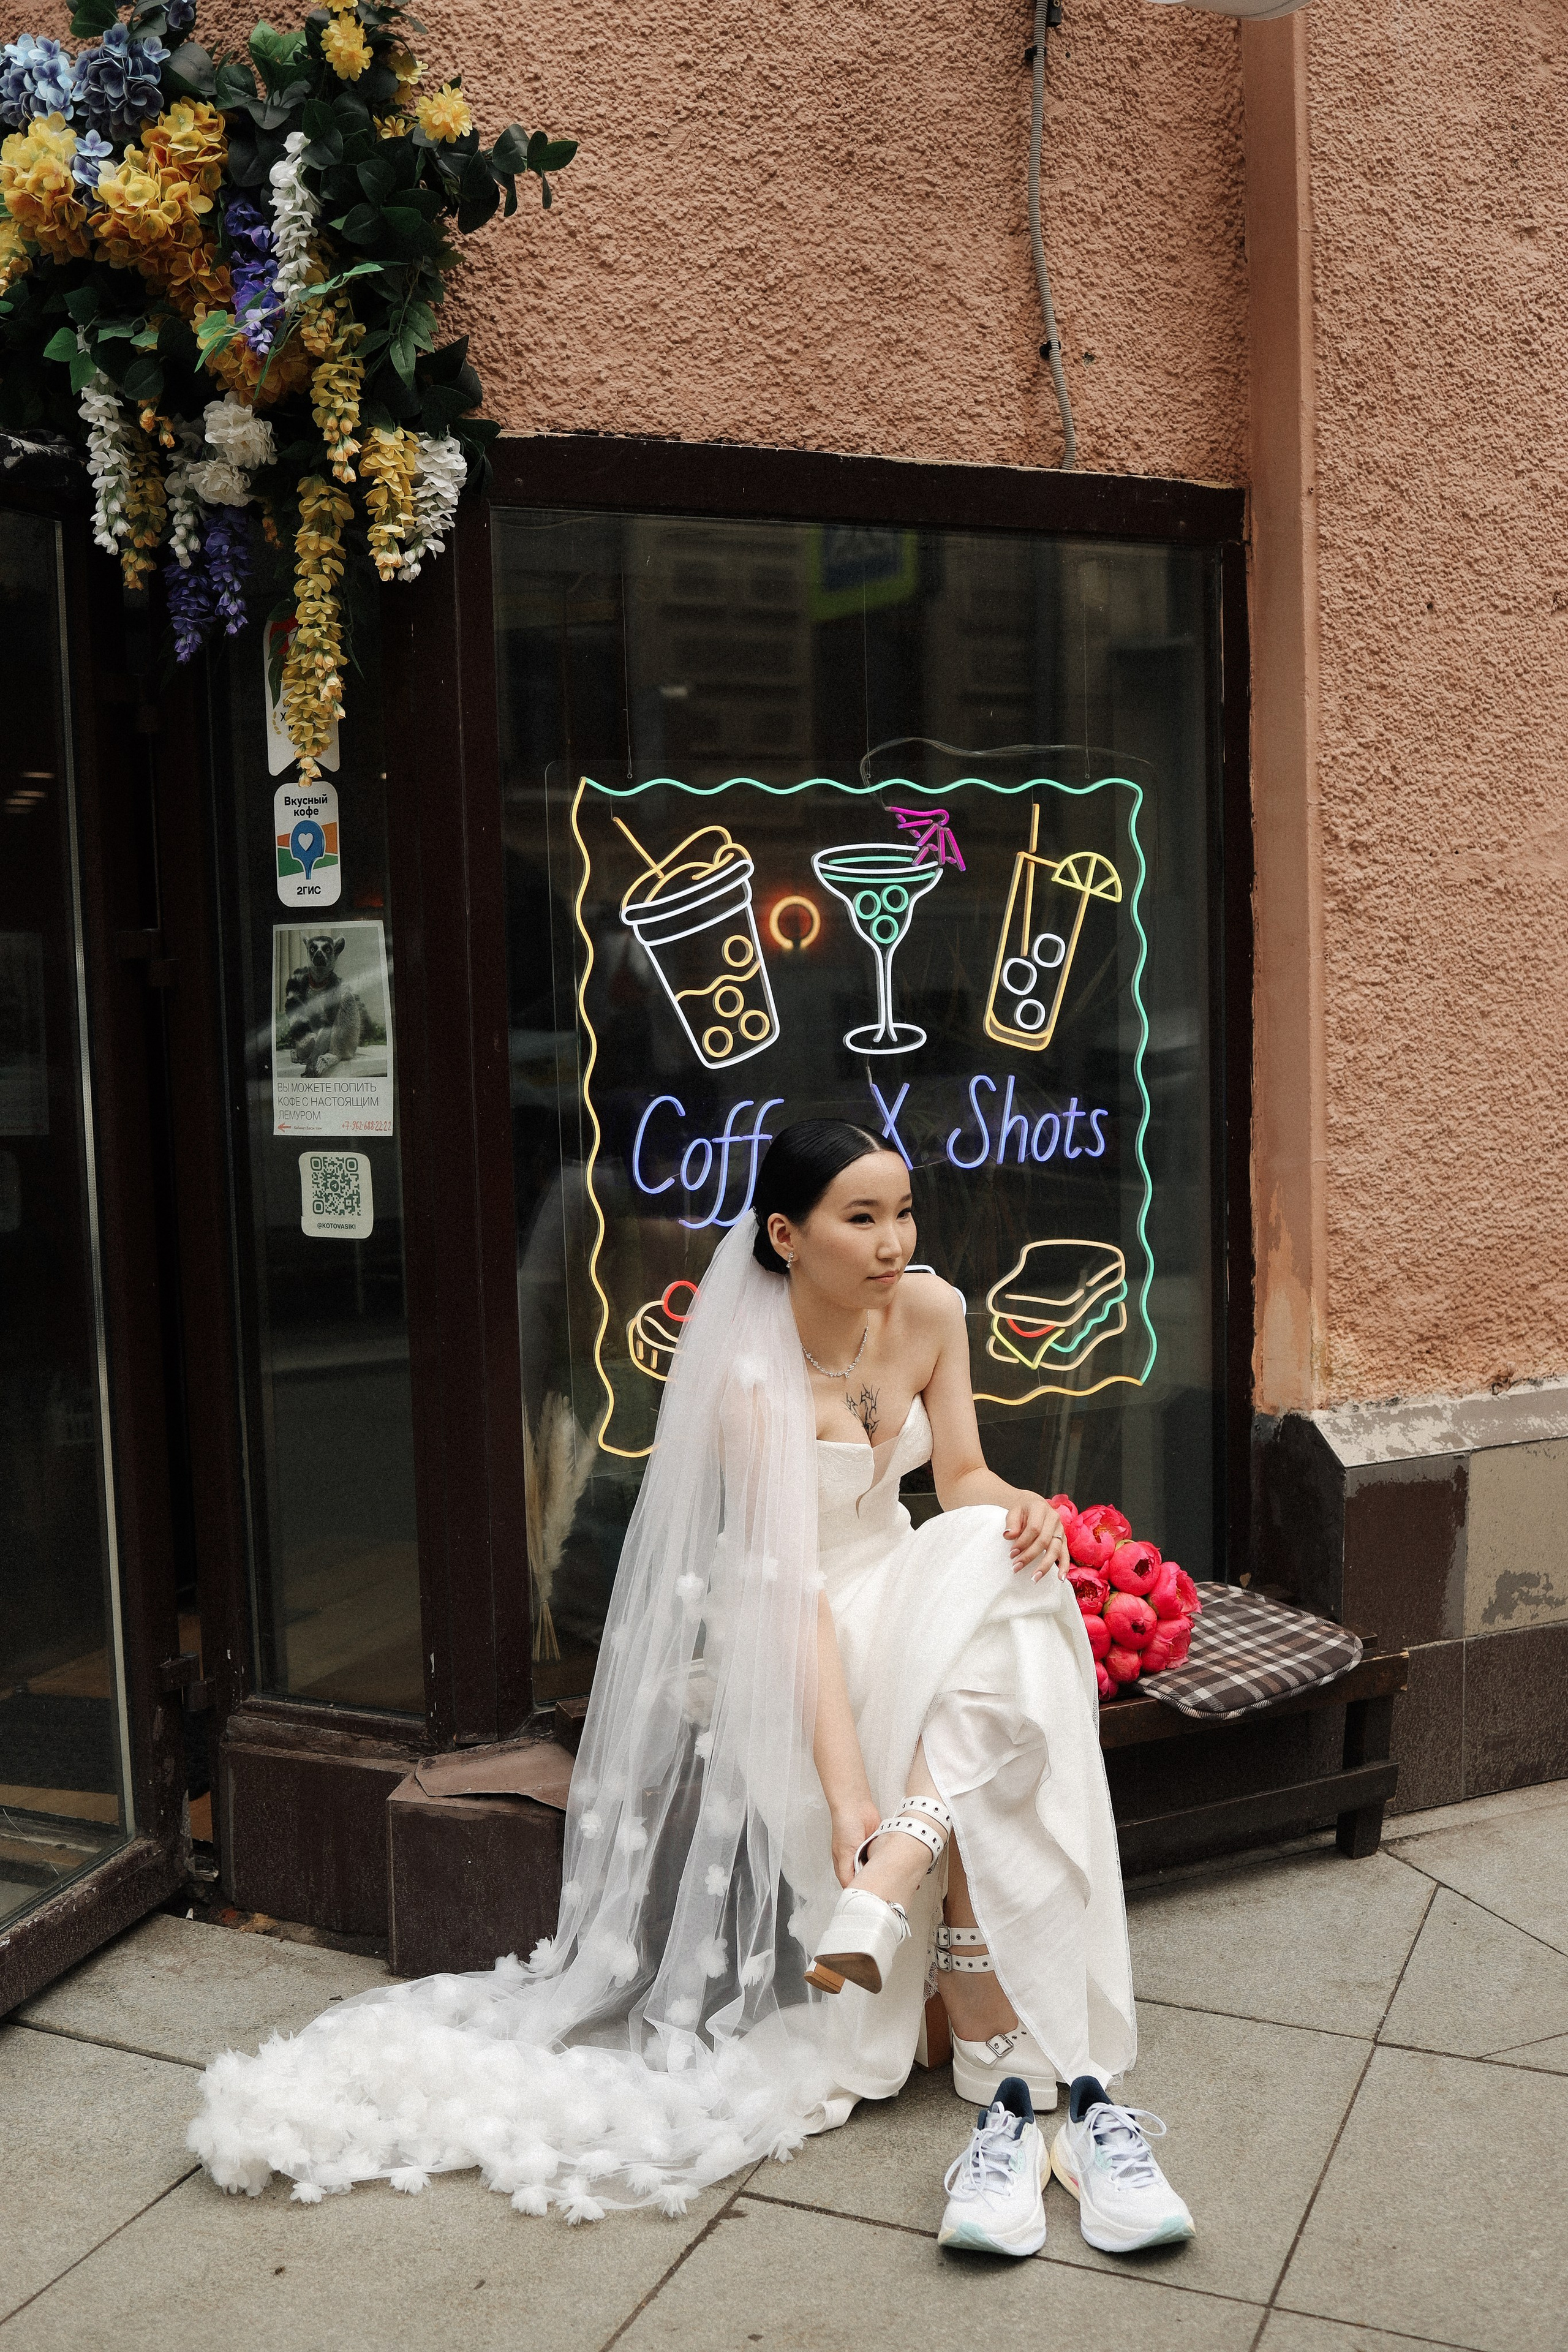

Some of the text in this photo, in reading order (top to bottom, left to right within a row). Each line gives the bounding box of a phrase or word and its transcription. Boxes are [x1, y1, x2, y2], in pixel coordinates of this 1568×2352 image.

[284, 793, 328, 807] Вкусный
[293, 805, 319, 818] кофе
[296, 886, 322, 895] 2ГИС
[277, 1082, 377, 1093] ВЫ МОЖЕТЕ ПОПИТЬ
[277, 1096, 379, 1109] КОФЕ С НАСТОЯЩИМ
[278, 1110, 322, 1120] ЛЕМУРОМ
[869, 1082, 914, 1171] X
[946, 1074, 1109, 1169] Shots
